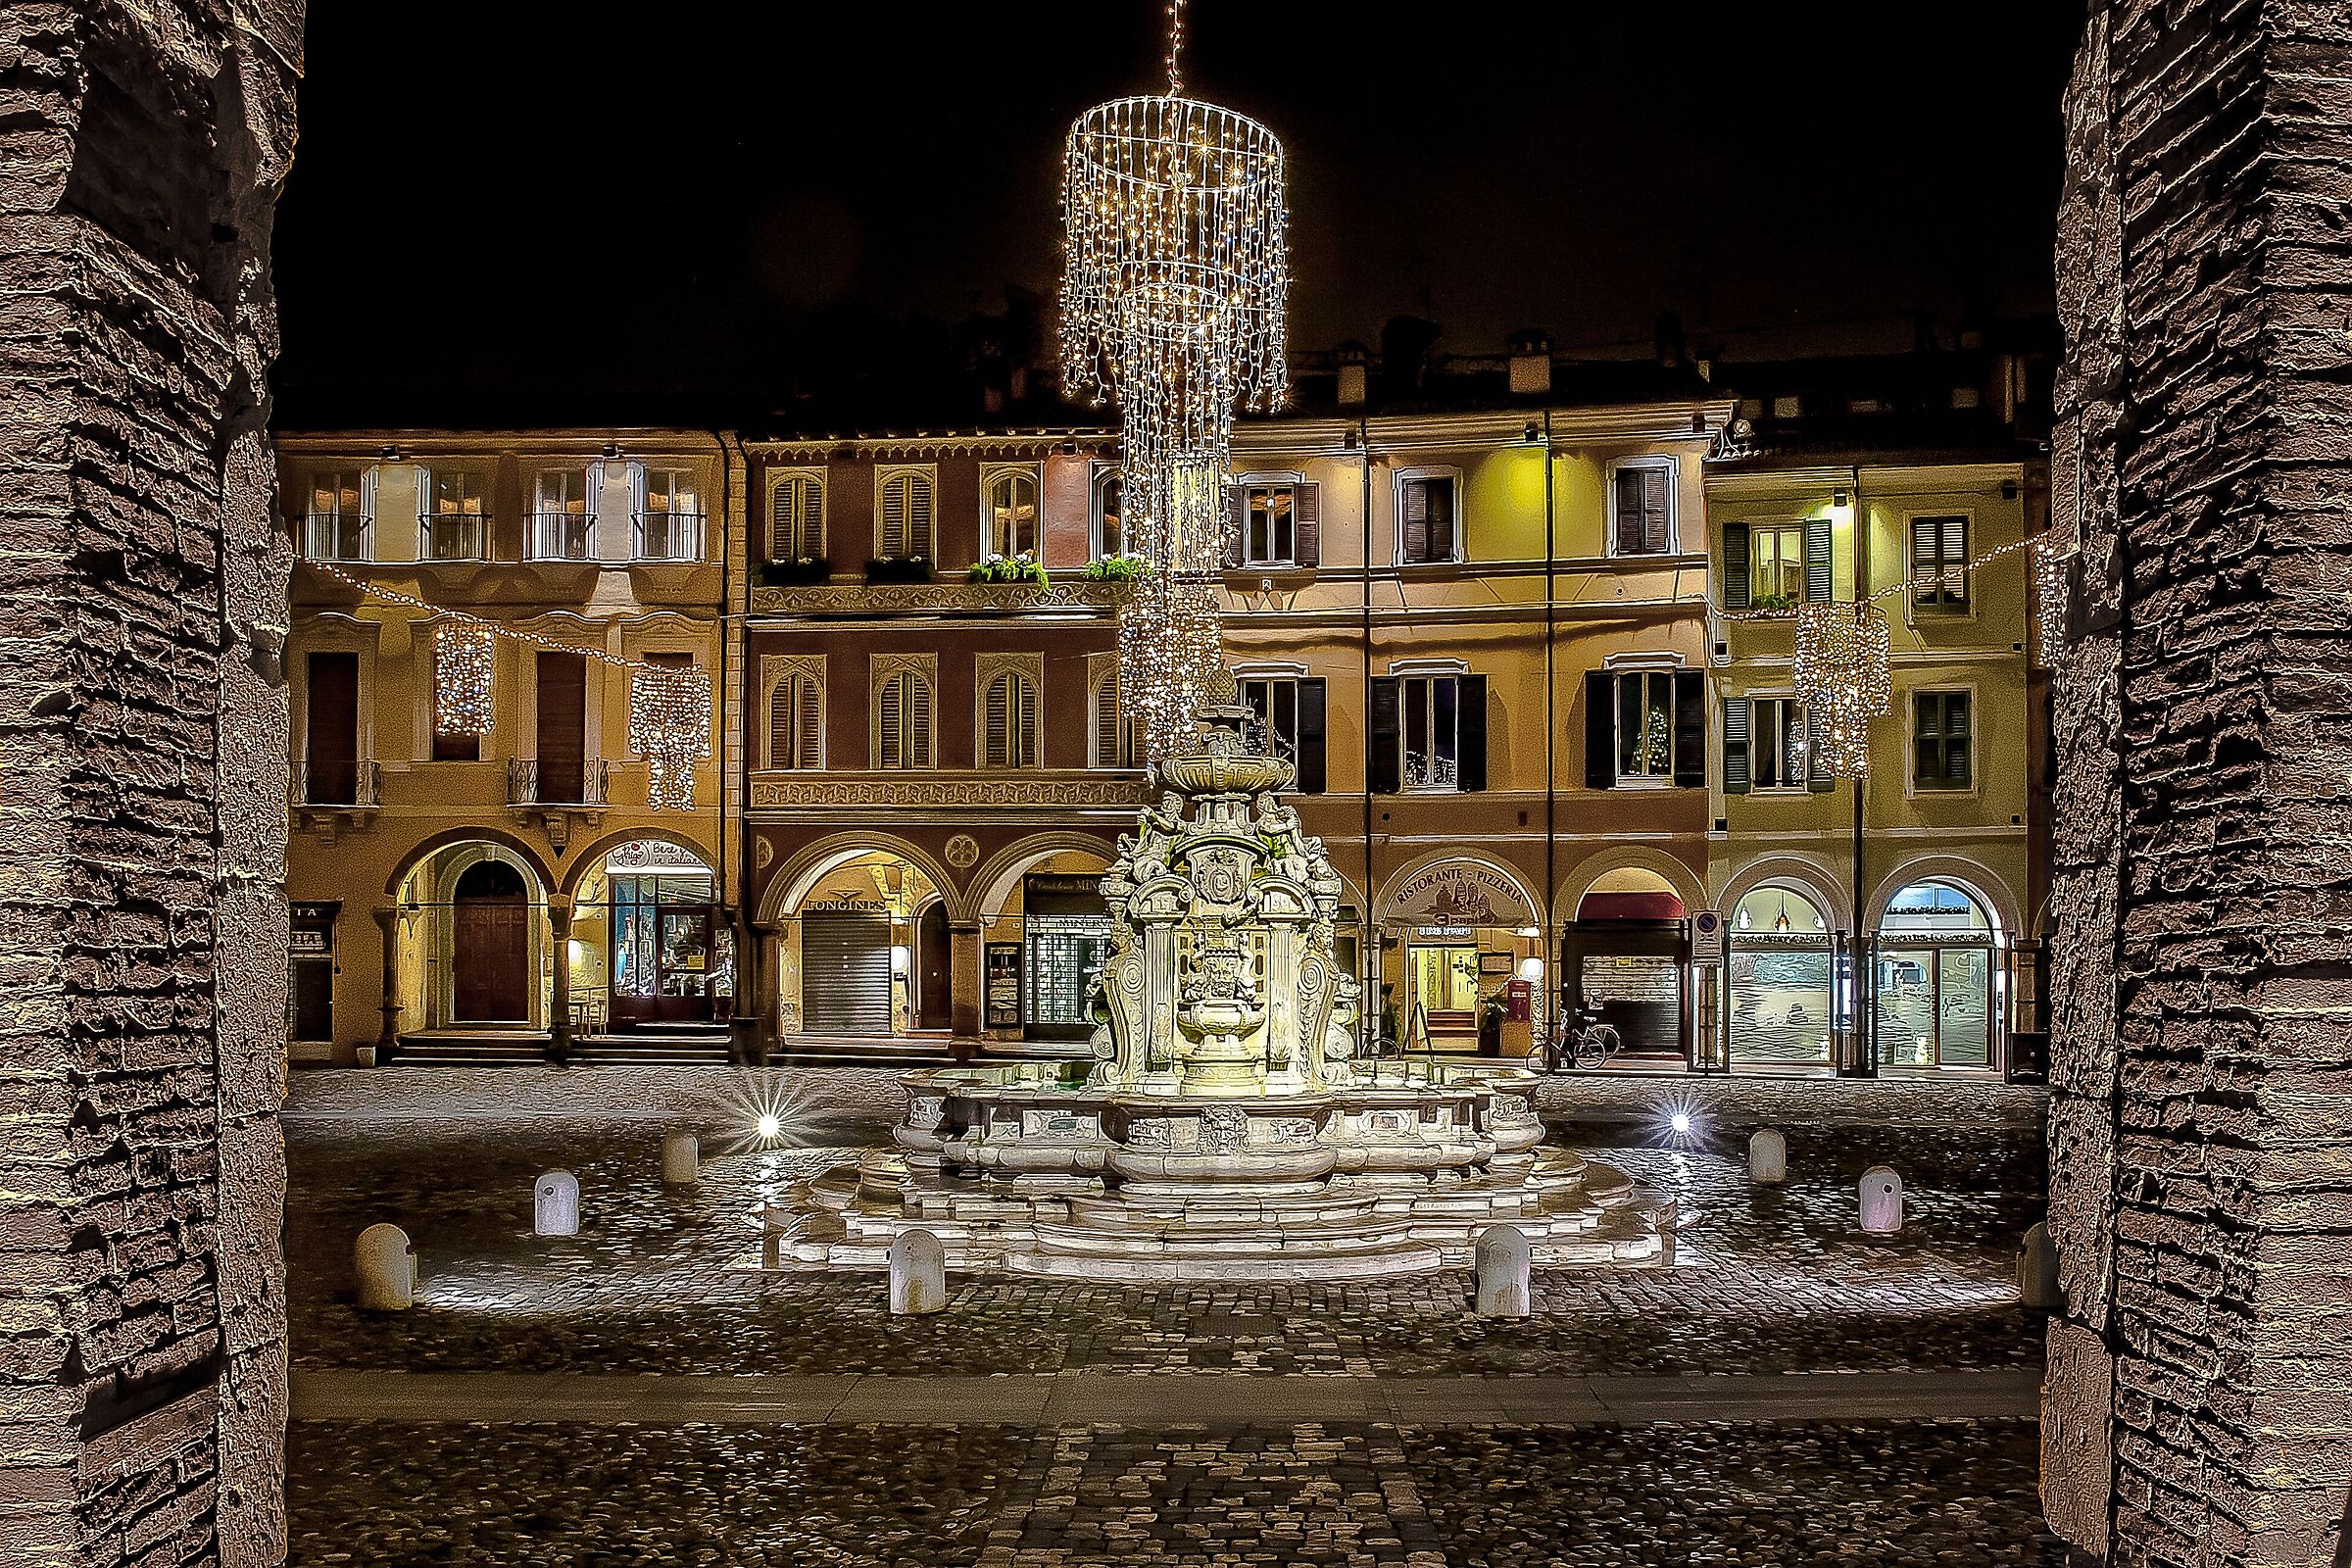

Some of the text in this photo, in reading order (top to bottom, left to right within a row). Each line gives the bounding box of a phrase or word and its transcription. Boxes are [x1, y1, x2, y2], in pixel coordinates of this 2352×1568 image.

[1396, 868, 1463, 906] RISTORANTE
[1476, 870, 1524, 906] PIZZERIA
[806, 901, 886, 912] LONGINES
